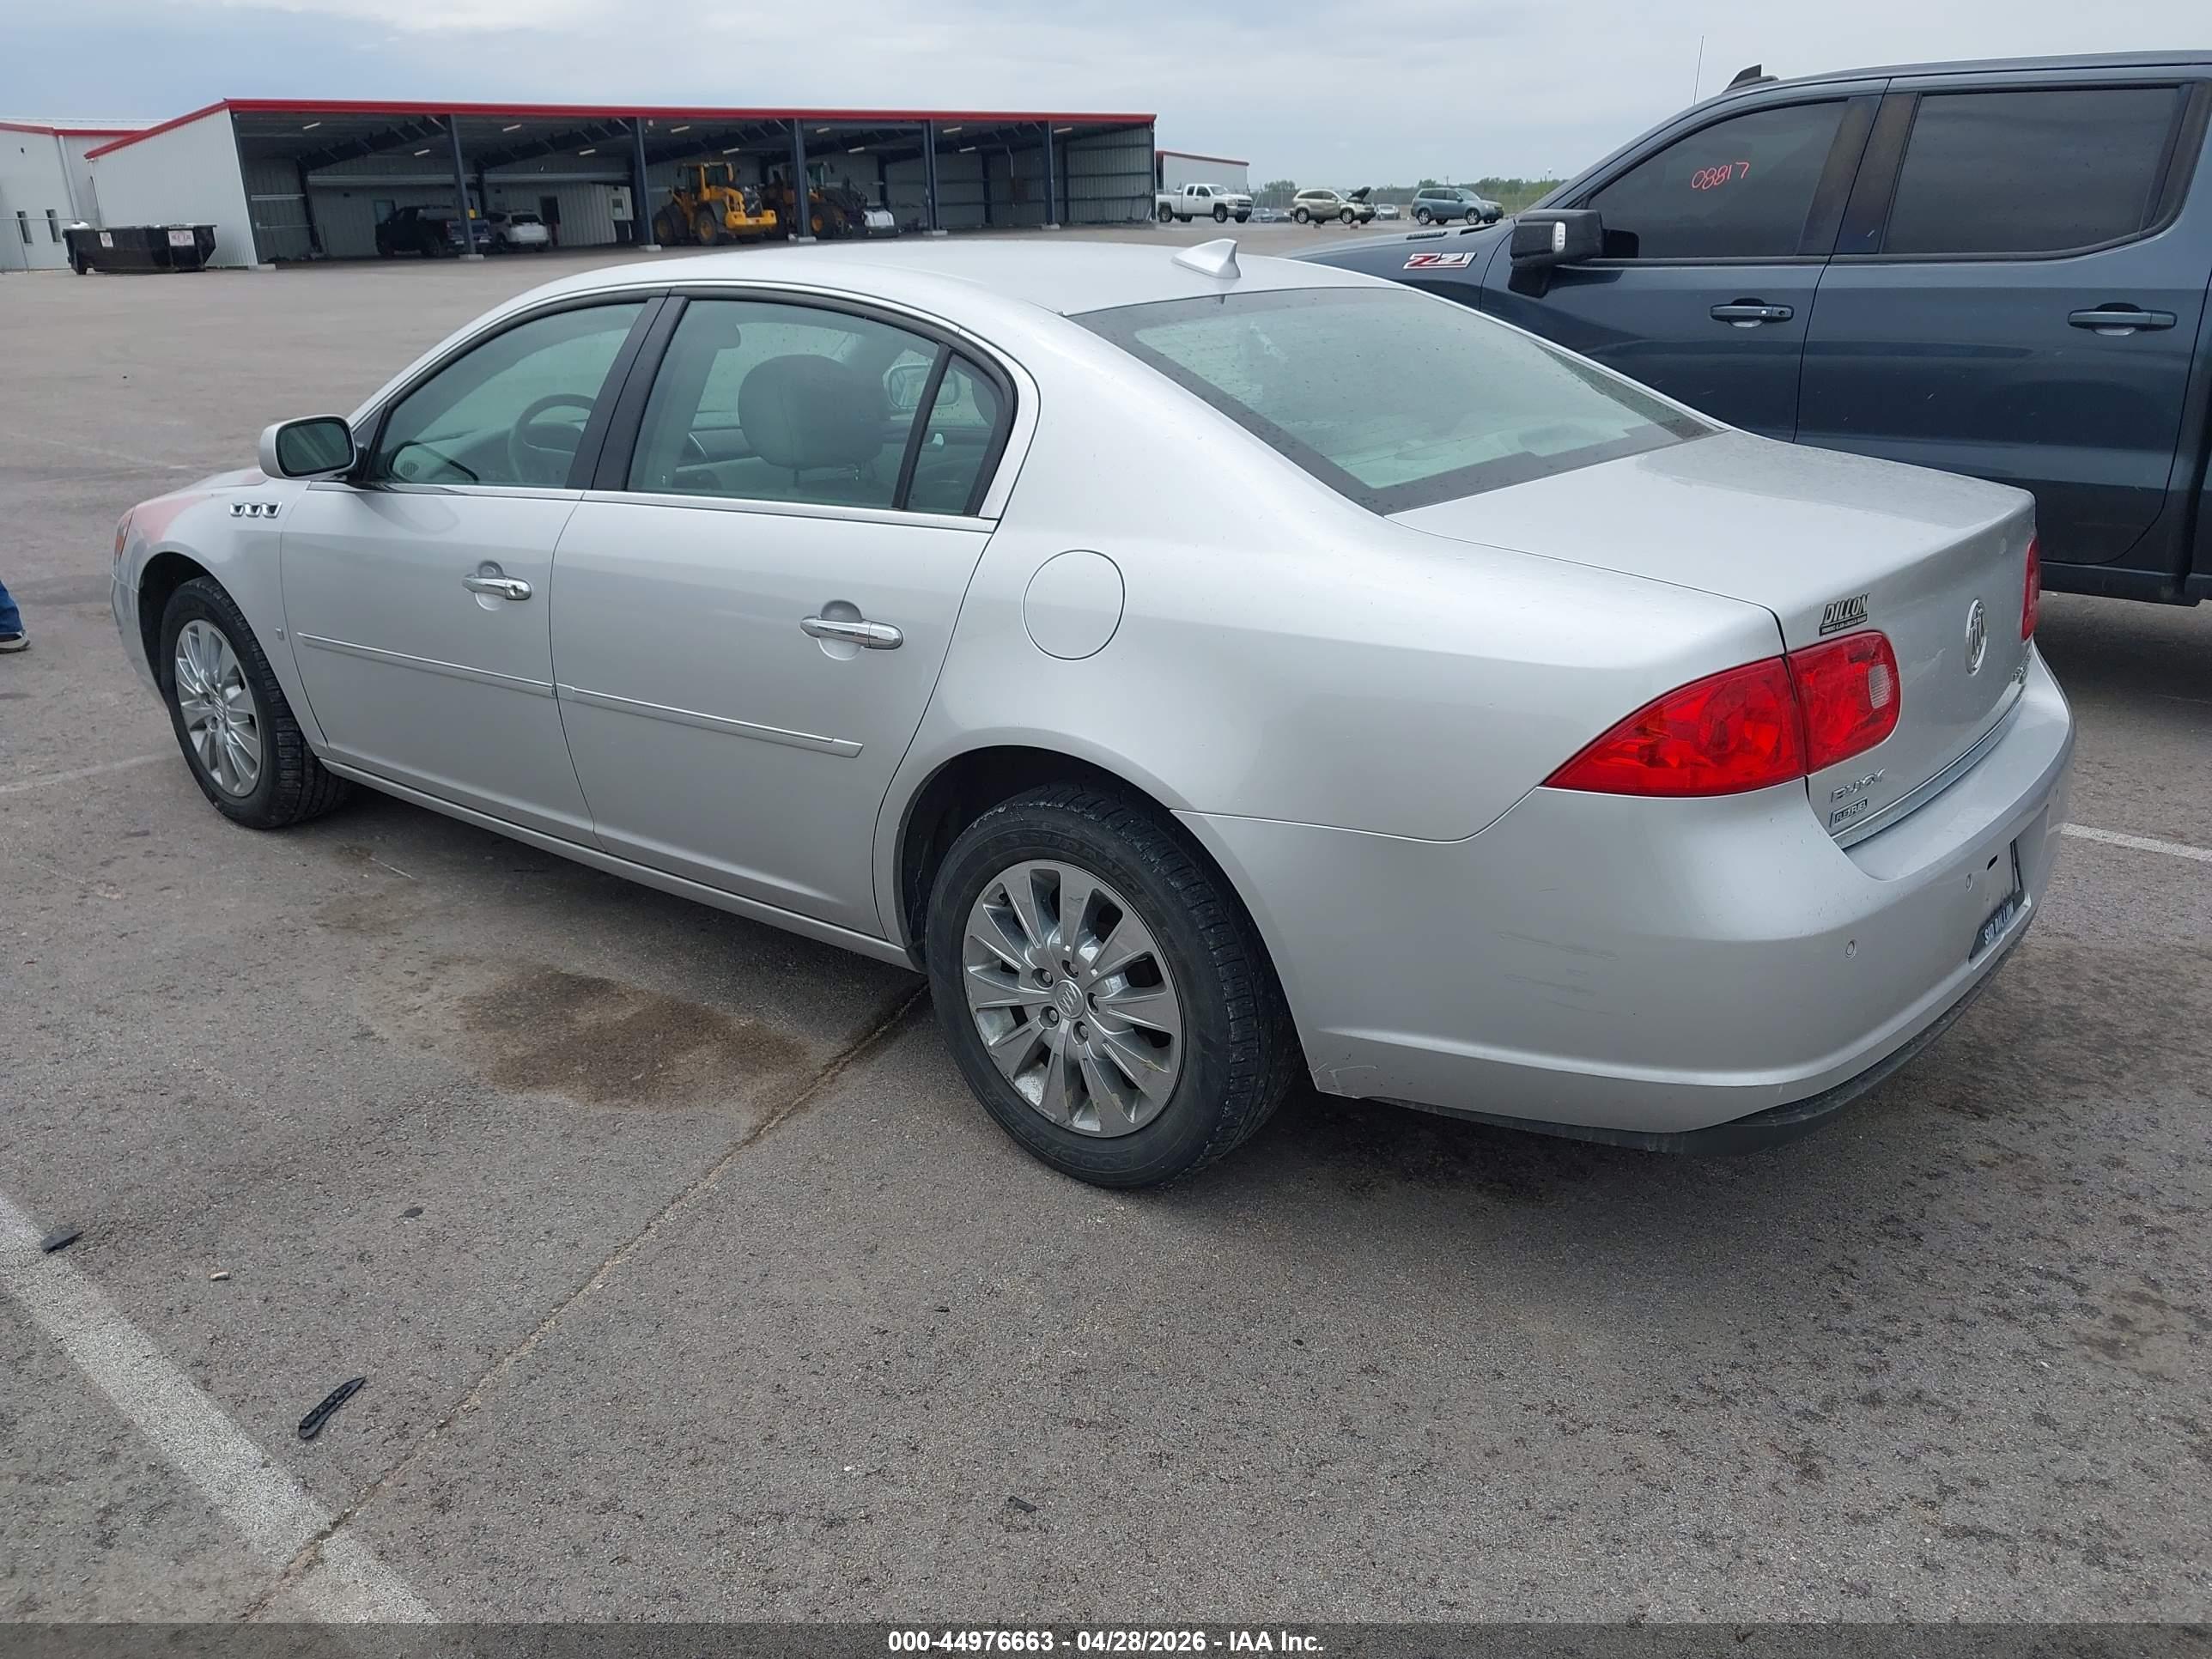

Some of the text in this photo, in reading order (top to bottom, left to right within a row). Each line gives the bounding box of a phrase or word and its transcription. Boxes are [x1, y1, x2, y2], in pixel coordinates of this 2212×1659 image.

[1691, 161, 1750, 190] 08817
[1402, 252, 1476, 270] Z71
[1821, 592, 1869, 625] DILLON
